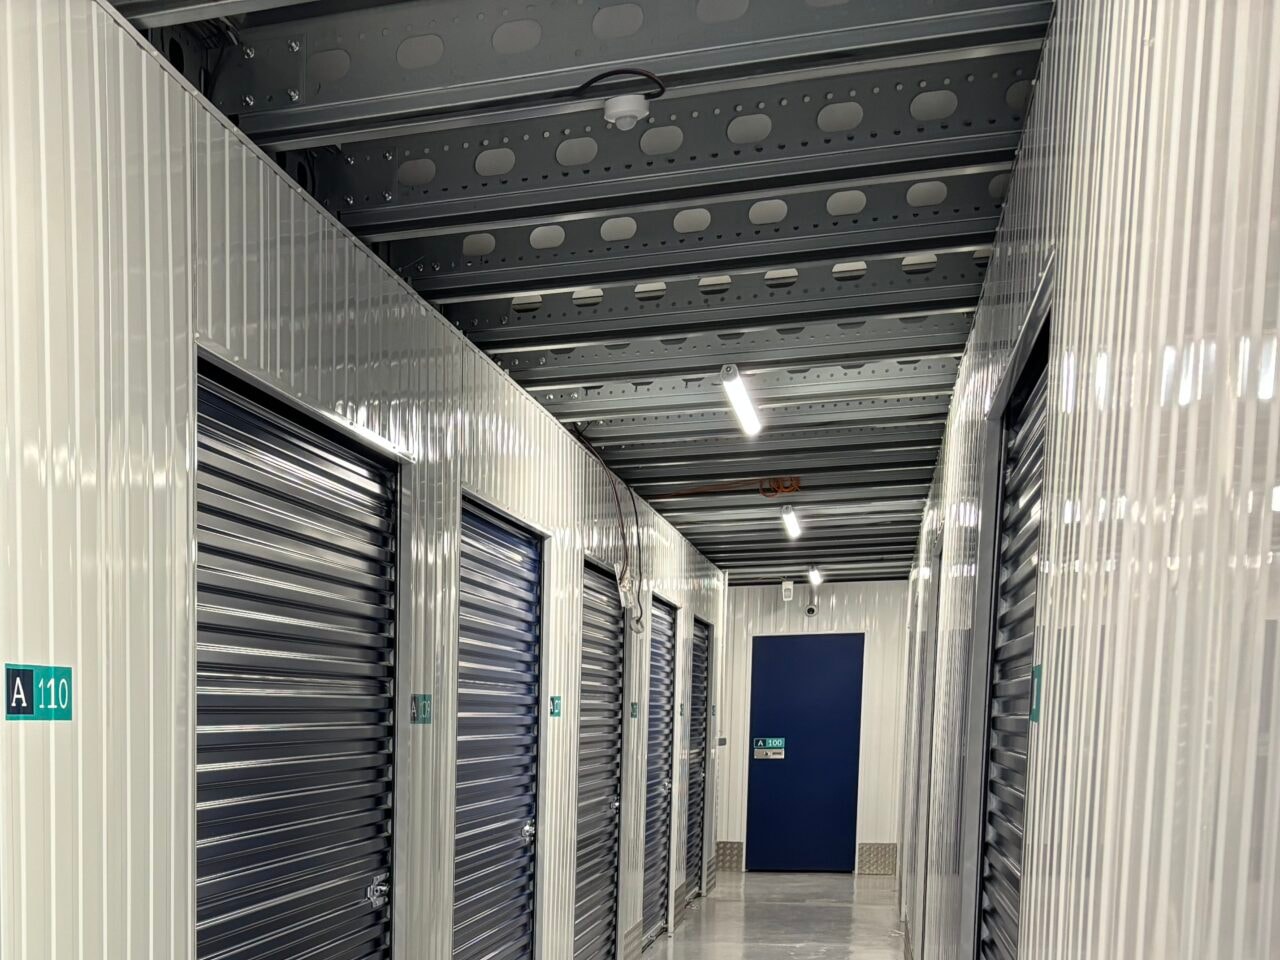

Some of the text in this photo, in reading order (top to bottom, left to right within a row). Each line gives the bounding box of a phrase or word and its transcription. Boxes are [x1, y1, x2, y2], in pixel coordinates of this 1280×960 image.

[11, 676, 68, 709] A 110
[410, 700, 417, 718] A
